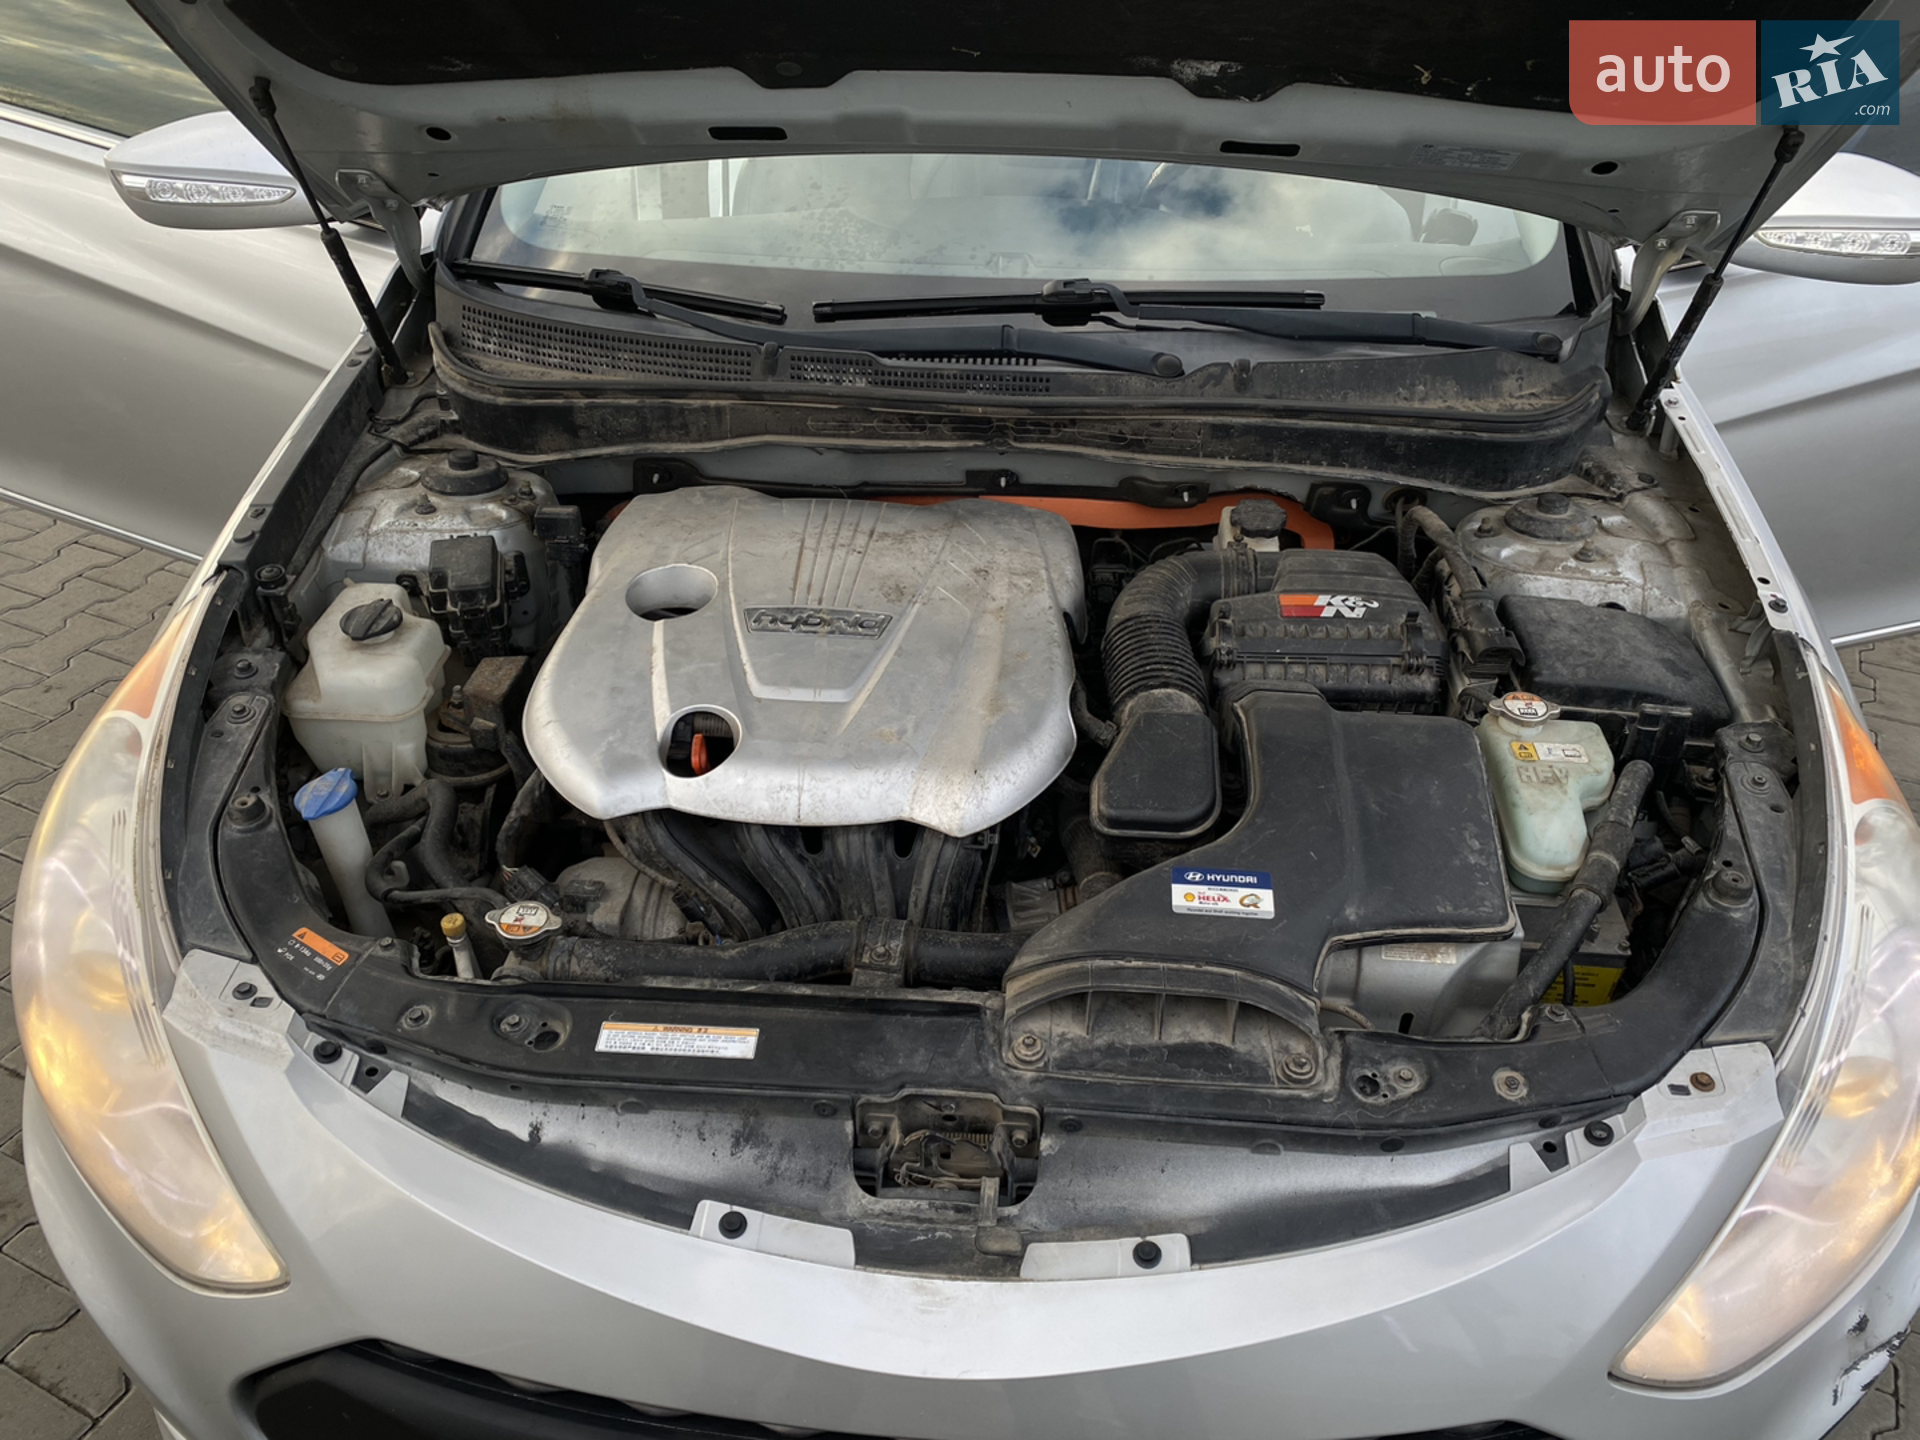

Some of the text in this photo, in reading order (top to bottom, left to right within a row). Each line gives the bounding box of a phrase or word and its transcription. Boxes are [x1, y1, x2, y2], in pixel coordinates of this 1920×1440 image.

[751, 609, 885, 632] hybrid
[1517, 765, 1569, 785] HEV
[1206, 873, 1258, 884] HYUNDAI
[1198, 894, 1231, 903] HELIX
[663, 1025, 693, 1034] WARNING
